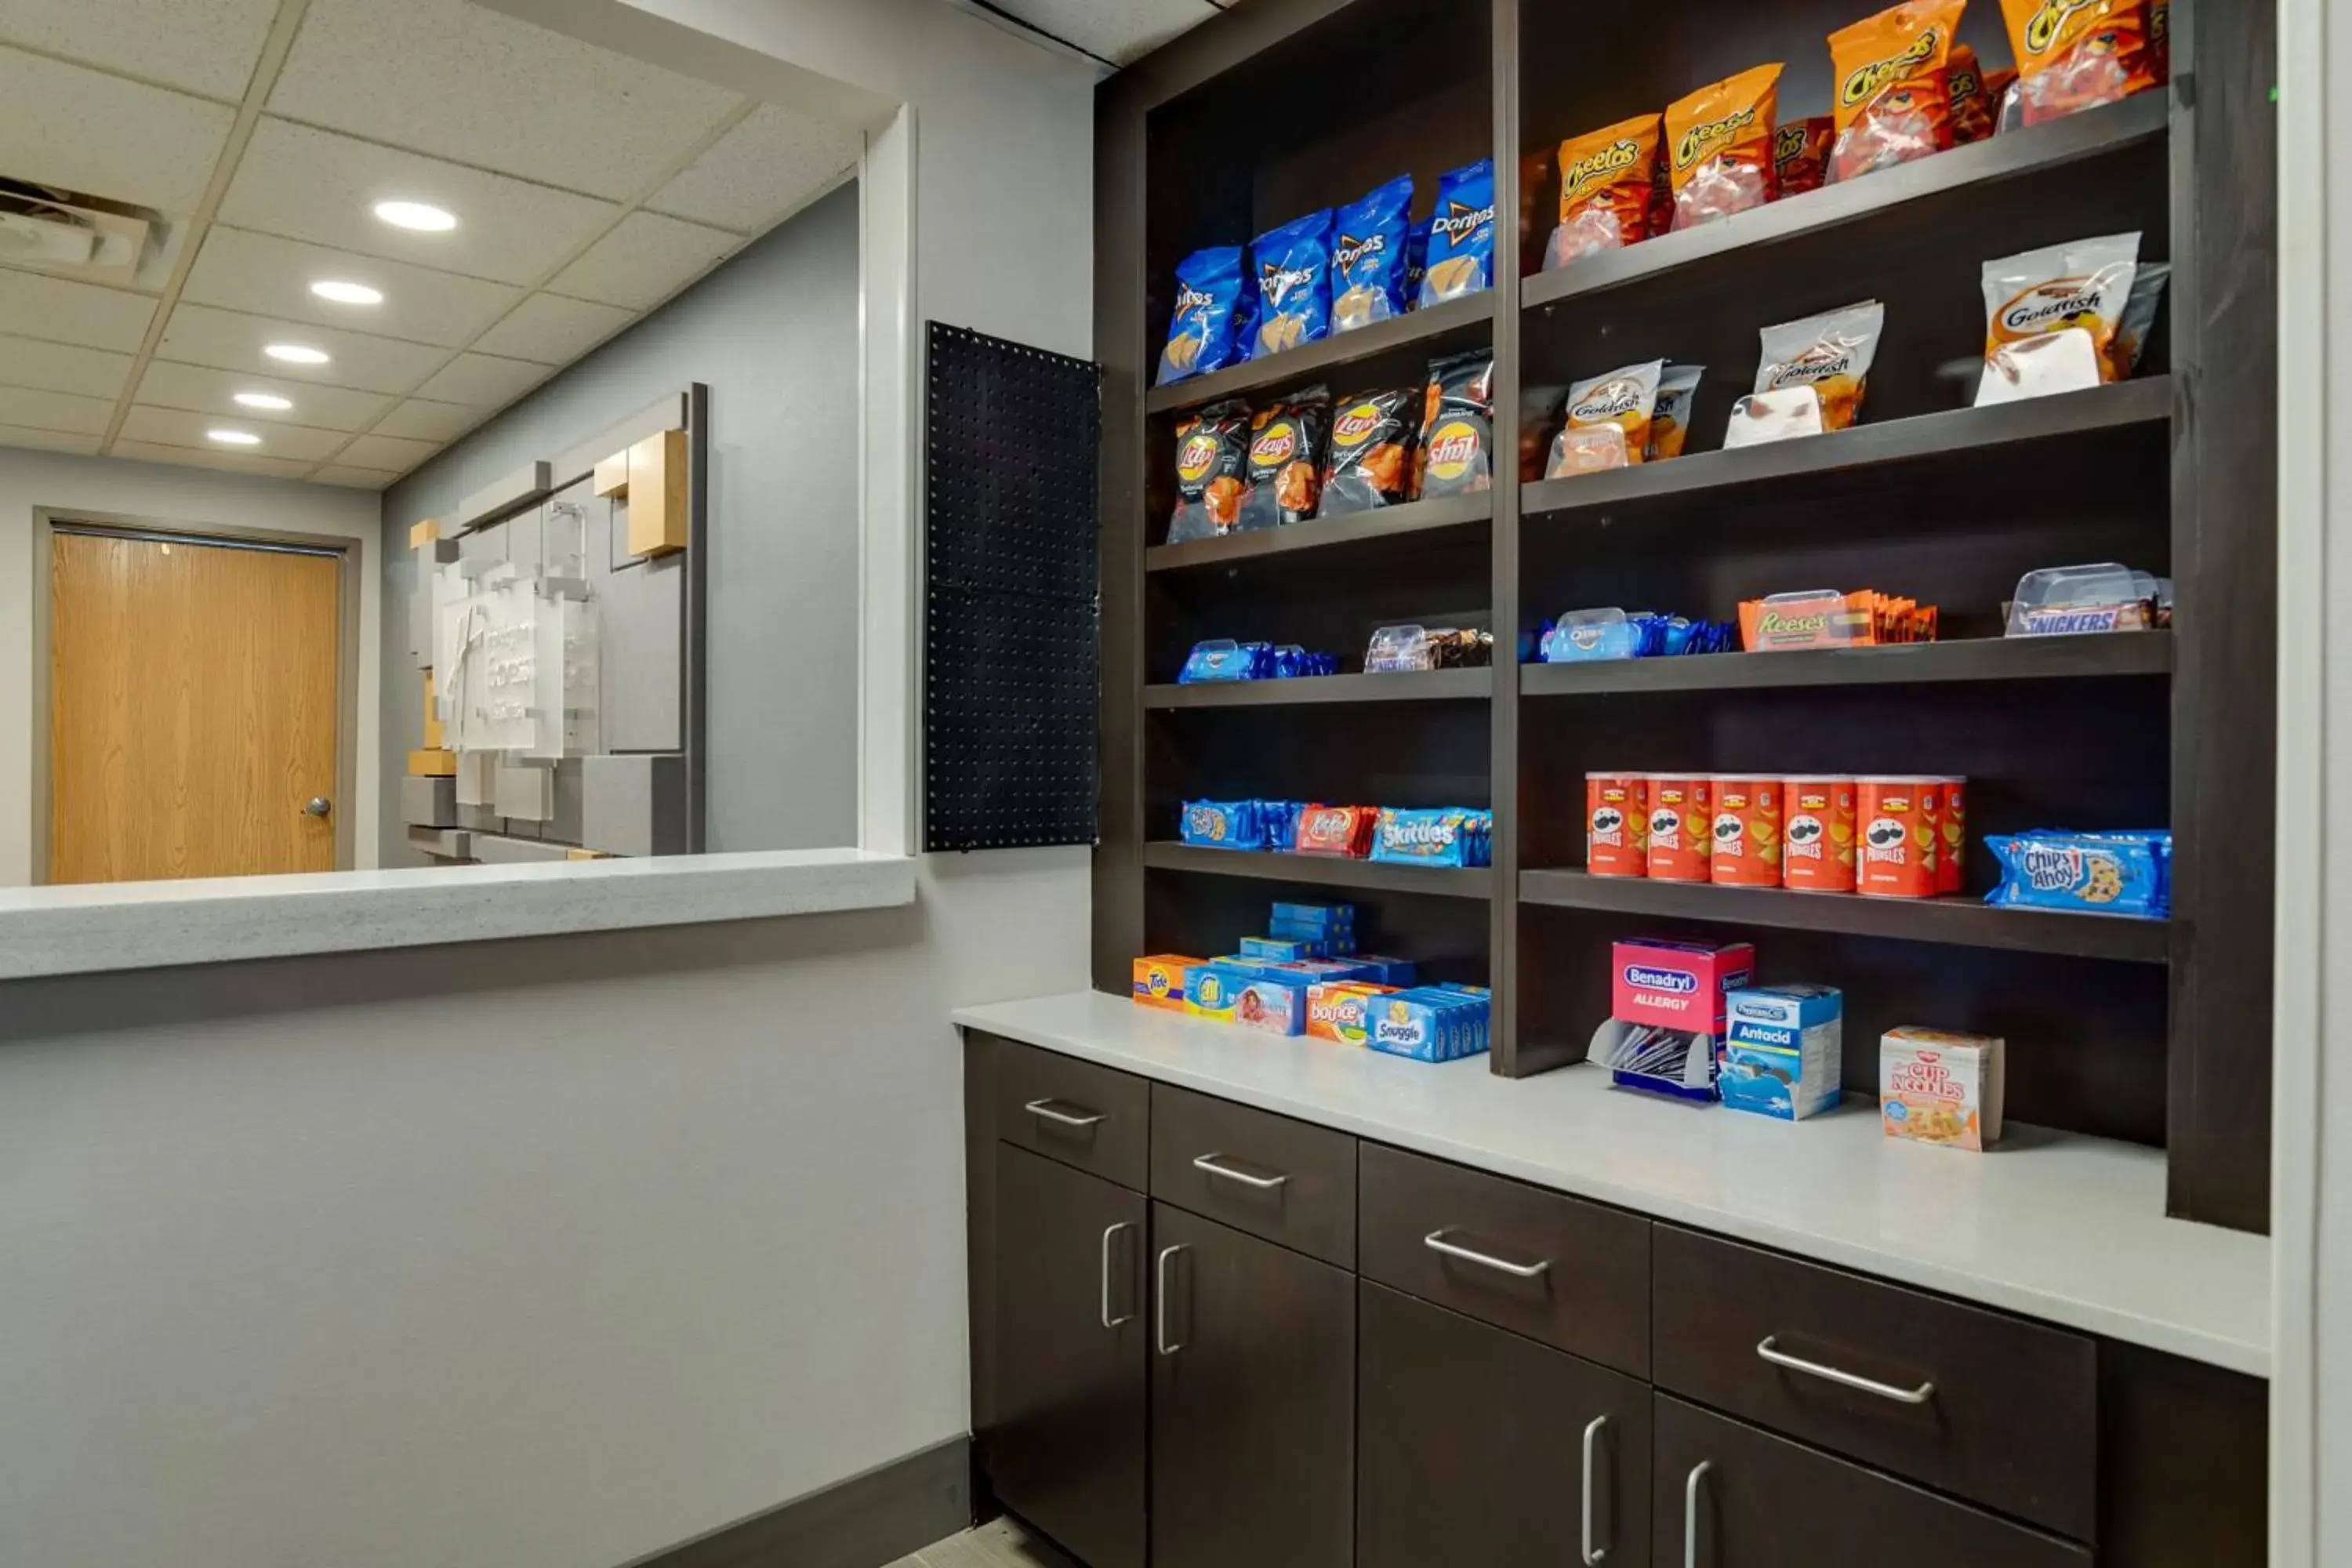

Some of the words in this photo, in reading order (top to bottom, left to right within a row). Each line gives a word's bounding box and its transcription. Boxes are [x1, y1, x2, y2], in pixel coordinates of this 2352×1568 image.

[1566, 143, 1639, 198] Cheetos
[1432, 205, 1494, 234] Doritos
[2007, 291, 2102, 328] Goldfish
[1574, 393, 1641, 418] Goldfish
[1630, 969, 1690, 991] Benadryl
[1311, 1001, 1356, 1022] bounce
[1633, 993, 1690, 1011] ALLERGY
[1378, 1023, 1421, 1042] Snuggle
[1740, 1025, 1791, 1044] Antacid
